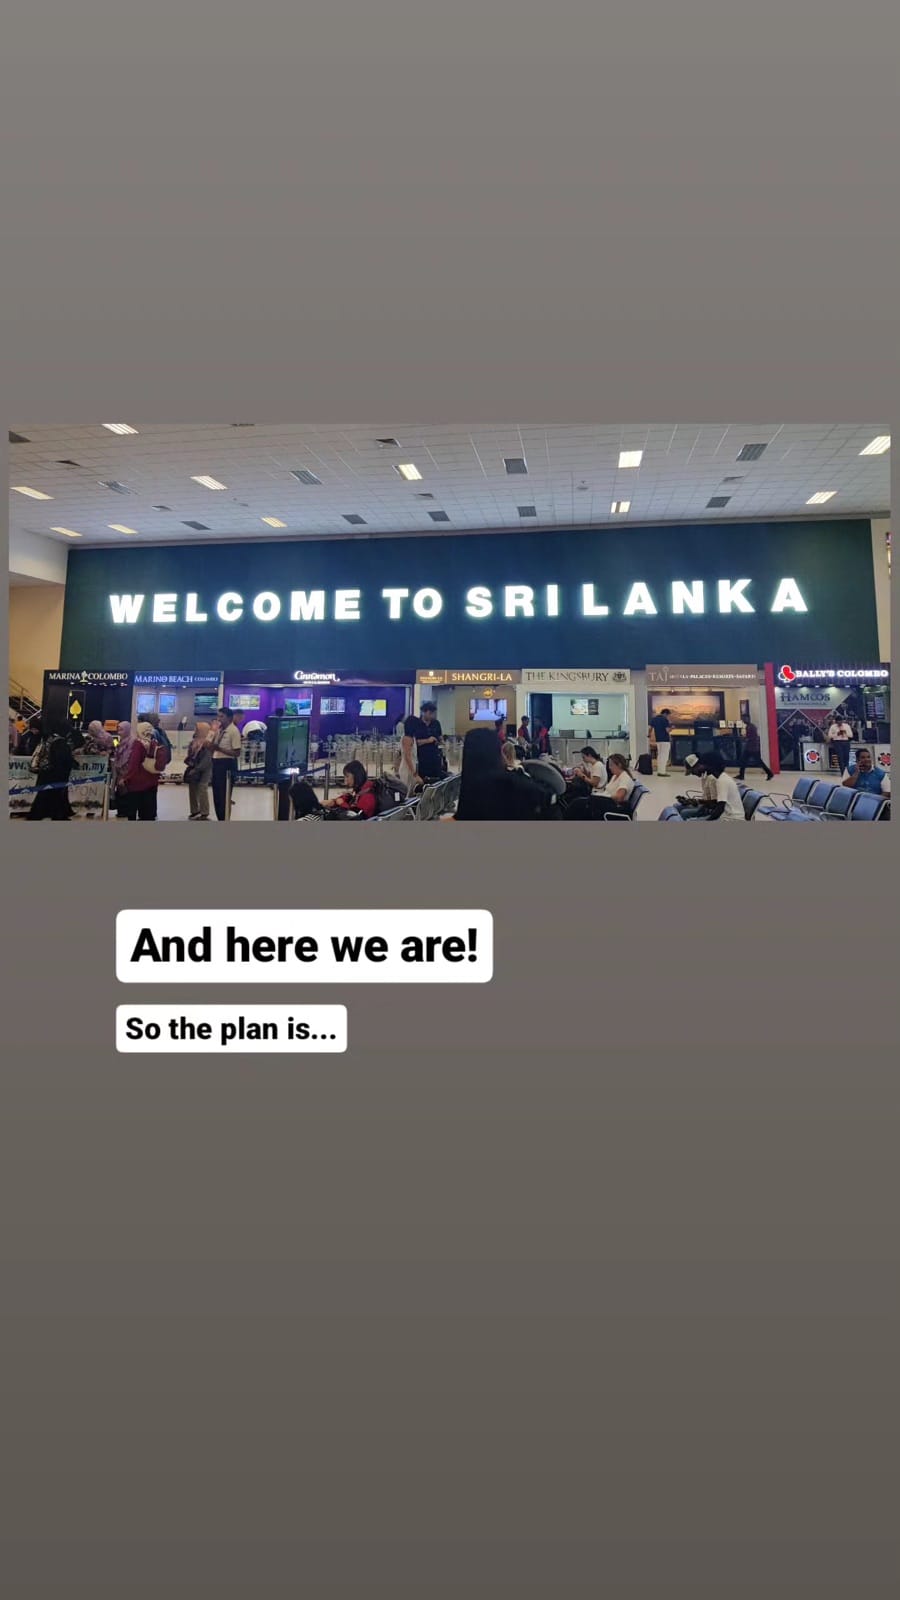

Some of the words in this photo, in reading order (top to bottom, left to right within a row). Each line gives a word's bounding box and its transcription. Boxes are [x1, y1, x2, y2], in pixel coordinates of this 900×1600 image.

[109, 592, 361, 623] WELCOME
[382, 588, 443, 619] TO
[465, 584, 559, 618] SRI
[582, 577, 809, 616] LANKA
[49, 672, 80, 680] MARINA
[88, 672, 128, 680] COLOMBO
[451, 672, 513, 681] SHANGRI-LA
[525, 671, 546, 681] THE
[549, 671, 609, 682] KINGSBURY
[648, 670, 669, 682] TAJ
[795, 669, 835, 678] BALLY'S
[837, 669, 889, 678] COLOMBO
[168, 675, 193, 683] BEACH
